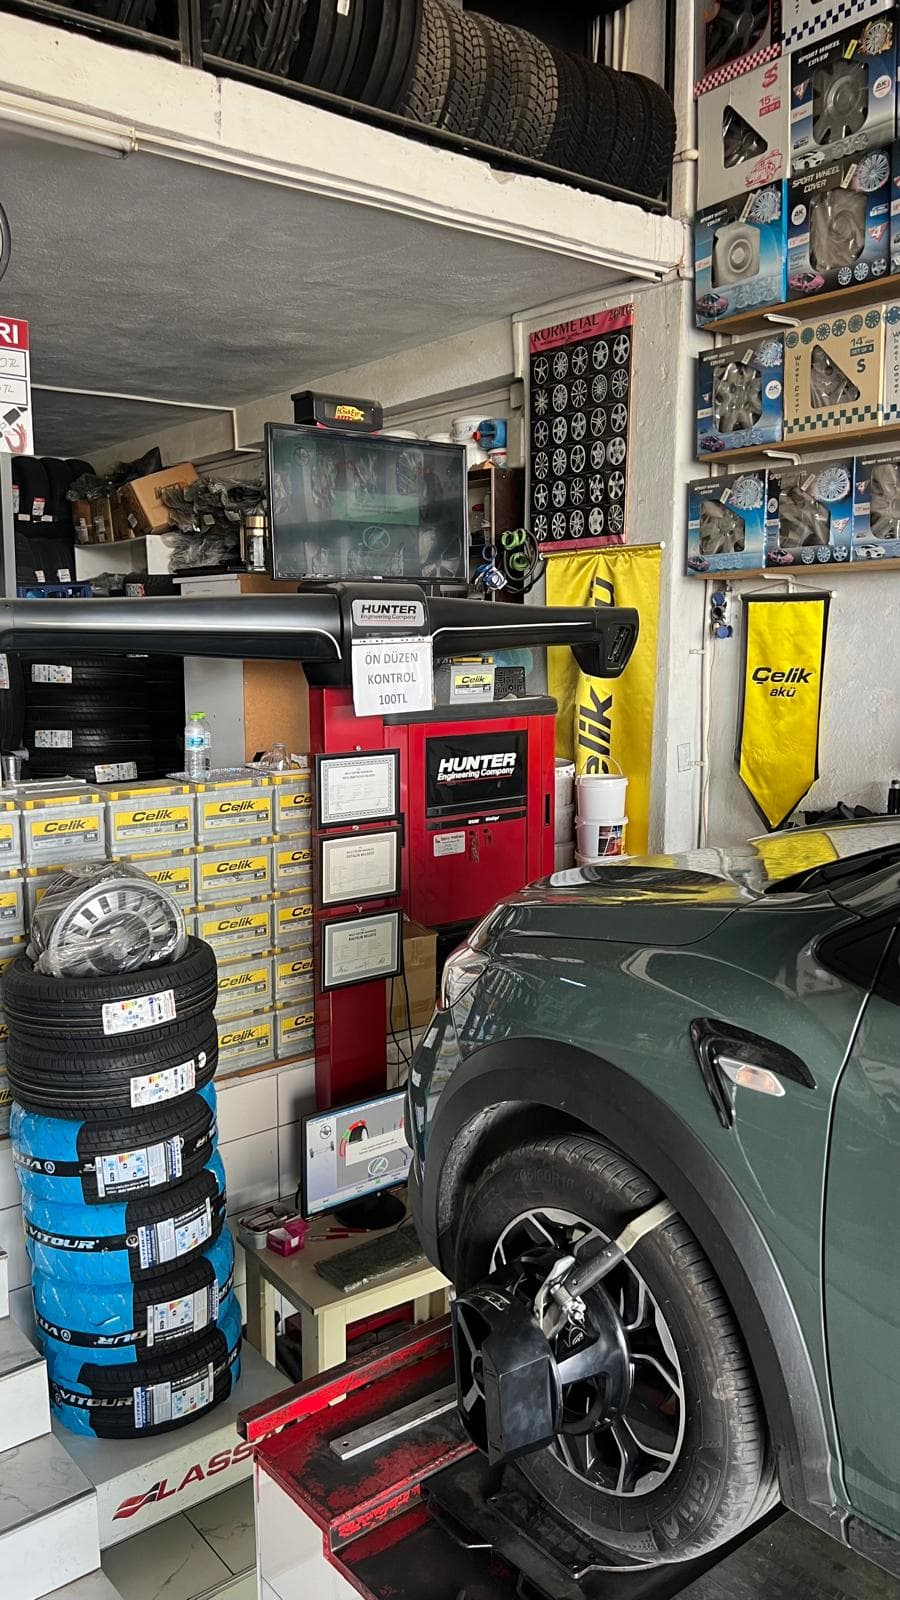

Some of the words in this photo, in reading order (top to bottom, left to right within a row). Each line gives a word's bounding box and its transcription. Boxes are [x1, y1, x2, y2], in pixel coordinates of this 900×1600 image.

[792, 174, 815, 189] SPORT
[815, 165, 840, 180] WHEEL
[803, 179, 827, 194] COVER
[533, 314, 600, 342] KORMETAL
[857, 358, 866, 373] S
[361, 604, 417, 615] HUNTER
[365, 651, 382, 665] ÖN
[384, 650, 419, 664] DÜZEN
[367, 672, 417, 685] KONTROL
[751, 667, 813, 685] Çelik
[378, 692, 409, 706] 100TL
[769, 686, 797, 698] akü
[438, 752, 517, 773] HUNTER
[437, 767, 480, 782] Engineering
[480, 766, 515, 779] Company
[218, 800, 255, 813] Celik
[131, 810, 173, 823] Celik
[43, 820, 87, 833] Celik
[216, 859, 253, 873] Celik
[217, 917, 254, 931] Celik
[218, 973, 254, 988] Celik
[220, 1029, 256, 1045] Celik
[28, 1226, 96, 1250] VITOUR
[59, 1388, 134, 1408] VITOUR
